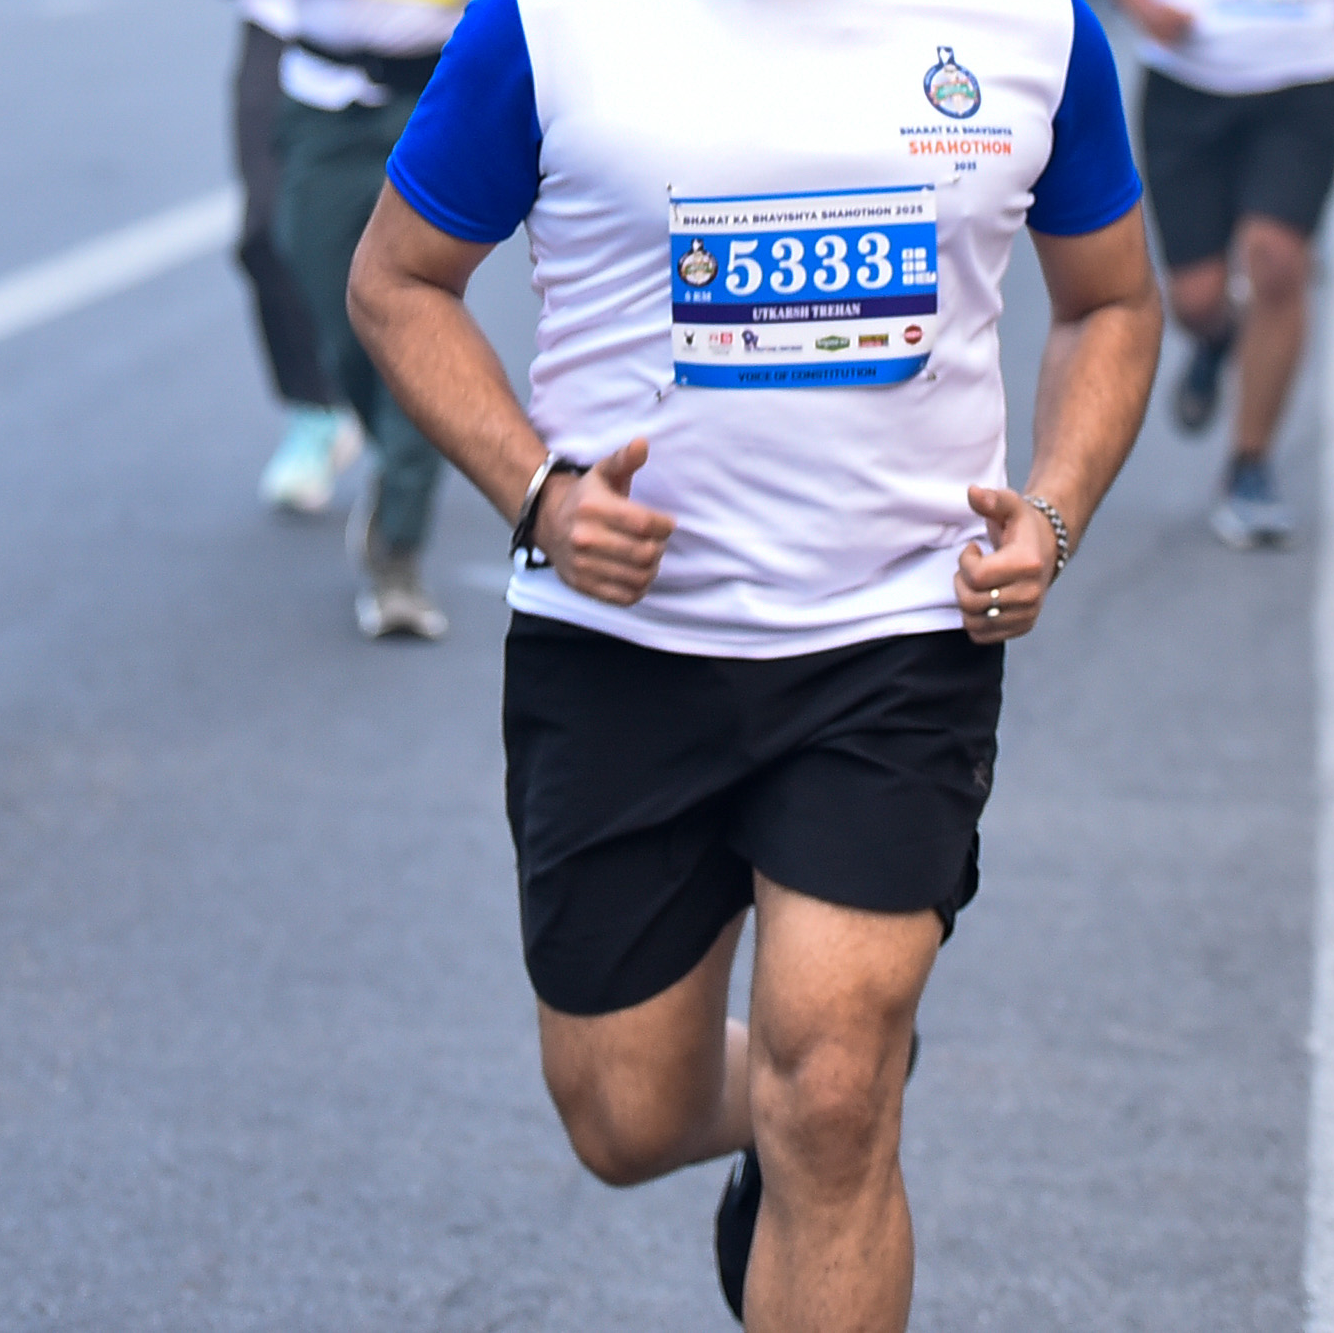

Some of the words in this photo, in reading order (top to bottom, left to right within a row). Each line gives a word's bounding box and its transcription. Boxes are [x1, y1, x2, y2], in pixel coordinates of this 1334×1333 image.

[909, 140, 1011, 154] SHAHOTHON
[683, 215, 730, 226] BHARAT
[733, 214, 748, 224] KA
[752, 211, 818, 224] BHAVISHYA
[821, 207, 892, 220] SHAHOTHON
[896, 204, 924, 215] 2025
[724, 231, 894, 297] 5333
[752, 305, 809, 321] UTKARSH
